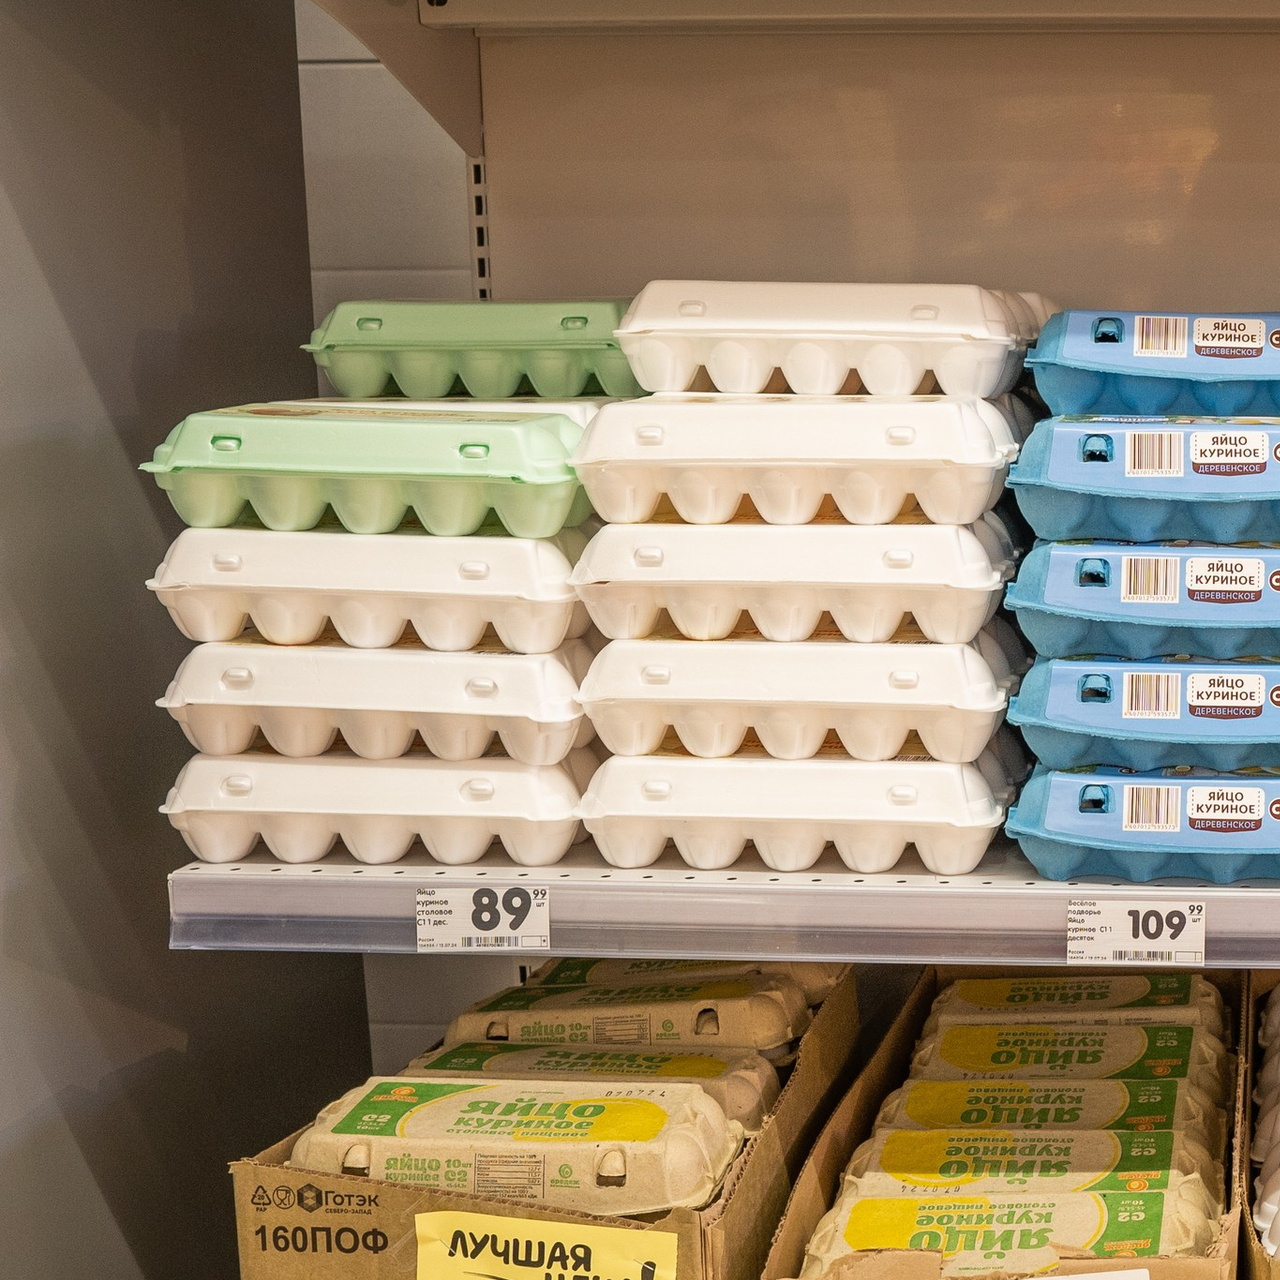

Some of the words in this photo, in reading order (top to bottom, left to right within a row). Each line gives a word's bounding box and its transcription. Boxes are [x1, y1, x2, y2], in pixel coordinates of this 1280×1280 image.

[1213, 321, 1246, 332] ЯЙЦО
[1202, 333, 1257, 343] КУРИНОЕ
[1201, 348, 1257, 356] ДЕРЕВЕНСКОЕ
[1211, 435, 1247, 446] ЯЙЦО
[1200, 449, 1259, 458] КУРИНОЕ
[1208, 677, 1244, 688] ЯЙЦО
[1196, 691, 1256, 701] КУРИНОЕ
[1208, 790, 1244, 802] ЯЙЦО
[1196, 804, 1255, 814] КУРИНОЕ
[1195, 821, 1256, 829] ДЕРЕВЕНСКОЕ
[533, 889, 547, 898] 99
[471, 887, 532, 931] 89
[1188, 905, 1203, 915] 99
[1128, 910, 1186, 940] 109
[255, 1225, 389, 1254] 160ПОФ
[448, 1229, 593, 1273] ЛУЧШАЯ
